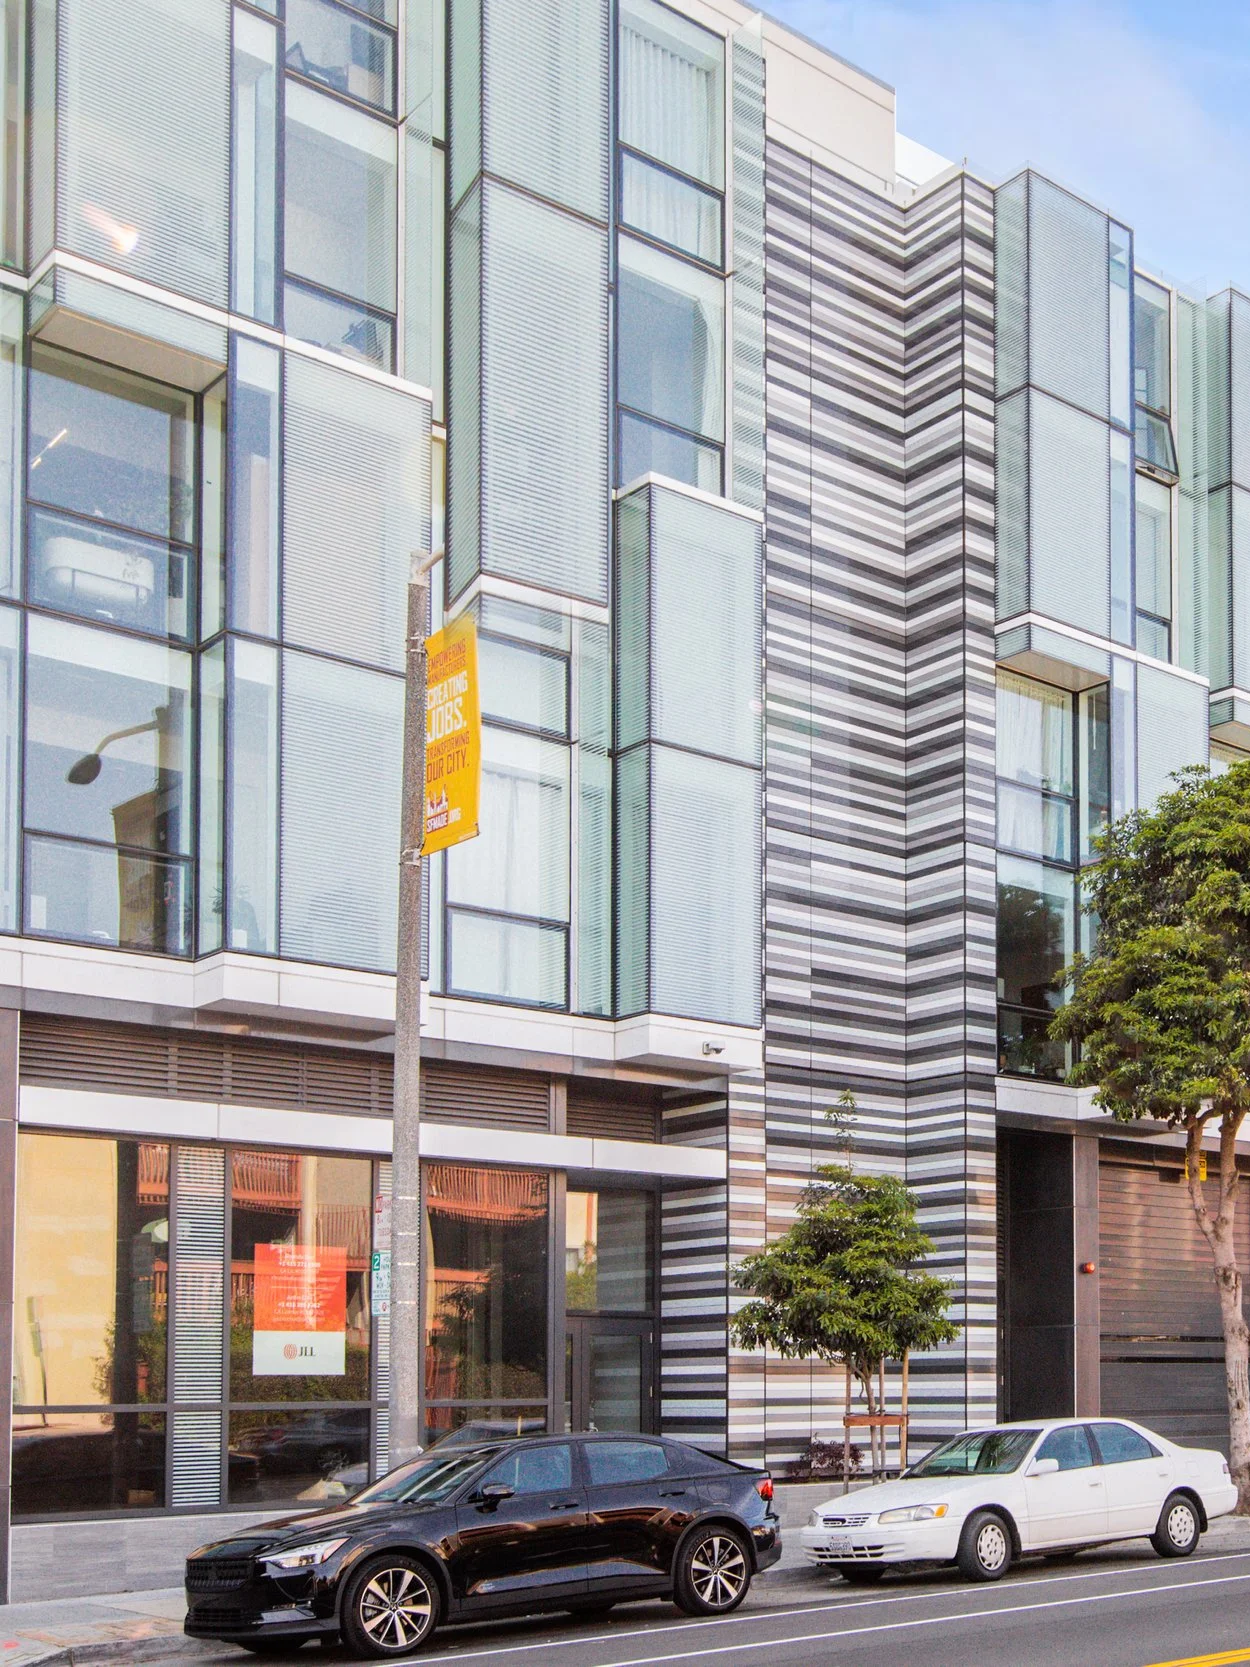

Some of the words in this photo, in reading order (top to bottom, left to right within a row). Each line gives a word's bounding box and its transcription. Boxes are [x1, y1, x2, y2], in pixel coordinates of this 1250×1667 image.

[428, 638, 466, 674] EMPOWERING
[427, 670, 468, 710] CREATING
[426, 696, 467, 742] JOBS.
[426, 731, 470, 760] TRANSFORMING
[426, 758, 444, 783] OUR
[446, 748, 470, 775] CITY.
[299, 1346, 316, 1357] JLL
